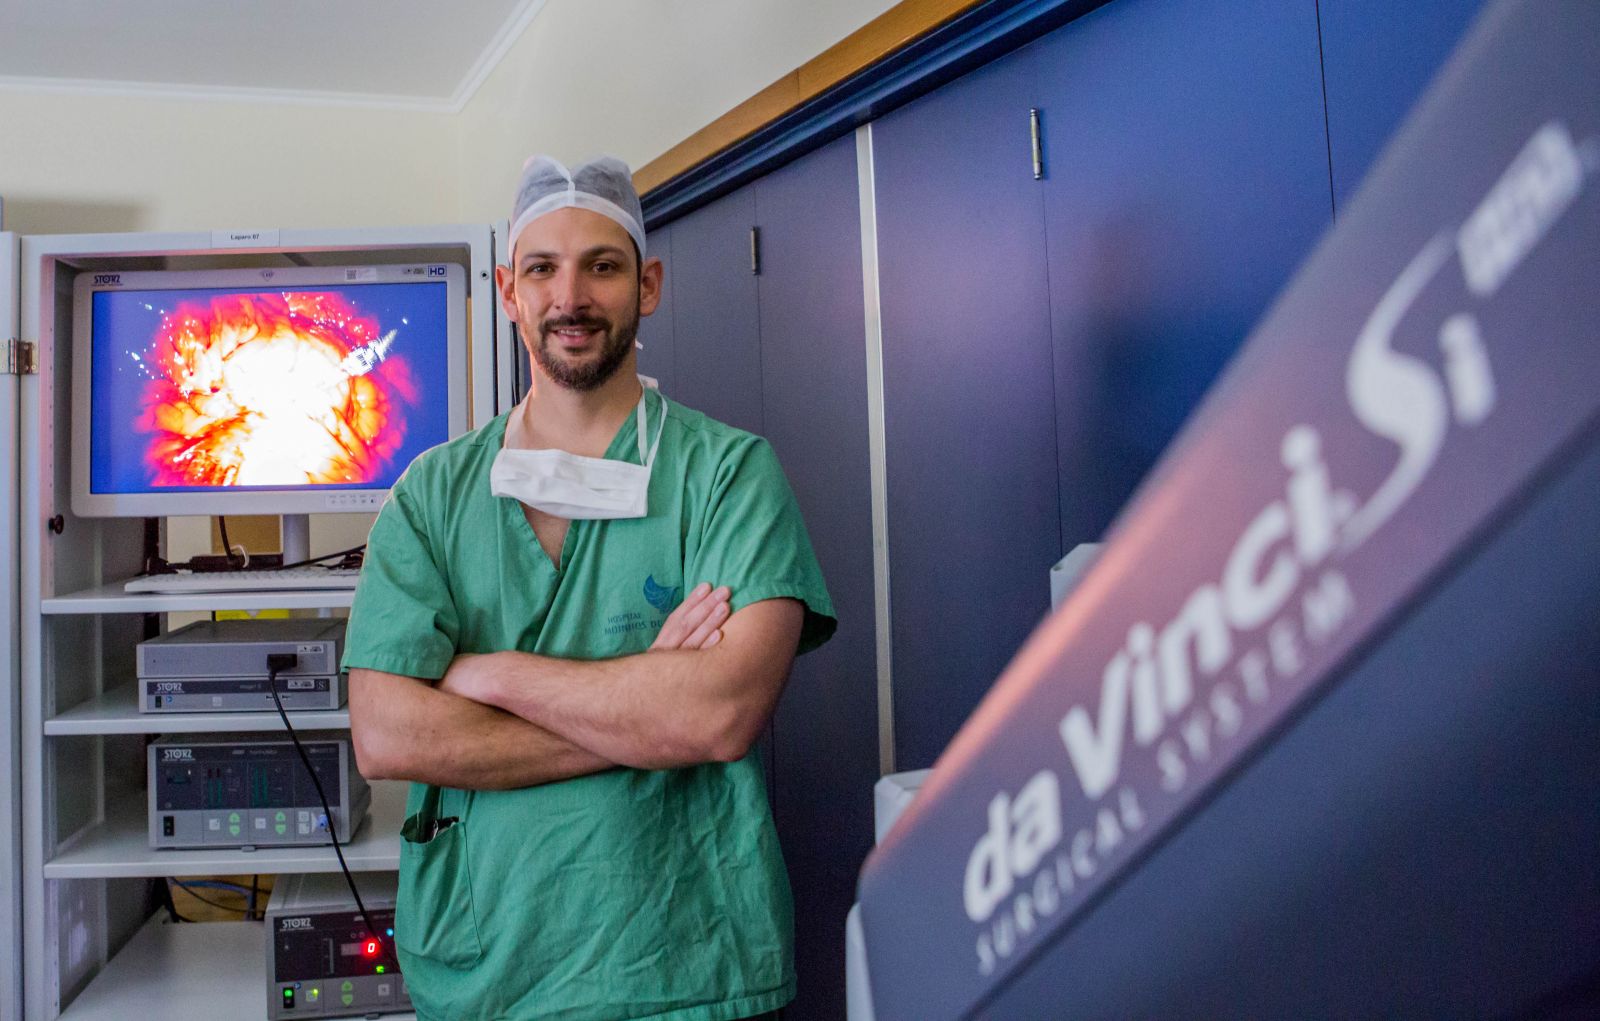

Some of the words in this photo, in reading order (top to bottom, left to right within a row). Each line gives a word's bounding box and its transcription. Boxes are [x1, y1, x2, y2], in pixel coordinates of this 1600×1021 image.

[429, 267, 445, 276] HD
[94, 274, 121, 284] STORZ
[607, 612, 641, 624] HOSPITAL
[964, 768, 1061, 923] da
[1059, 424, 1337, 799] Vinci
[156, 682, 182, 692] STORZ
[164, 749, 192, 759] STORZ
[975, 786, 1147, 976] SURGICAL
[1154, 568, 1357, 790] SYSTEM
[282, 917, 312, 929] STORZ
